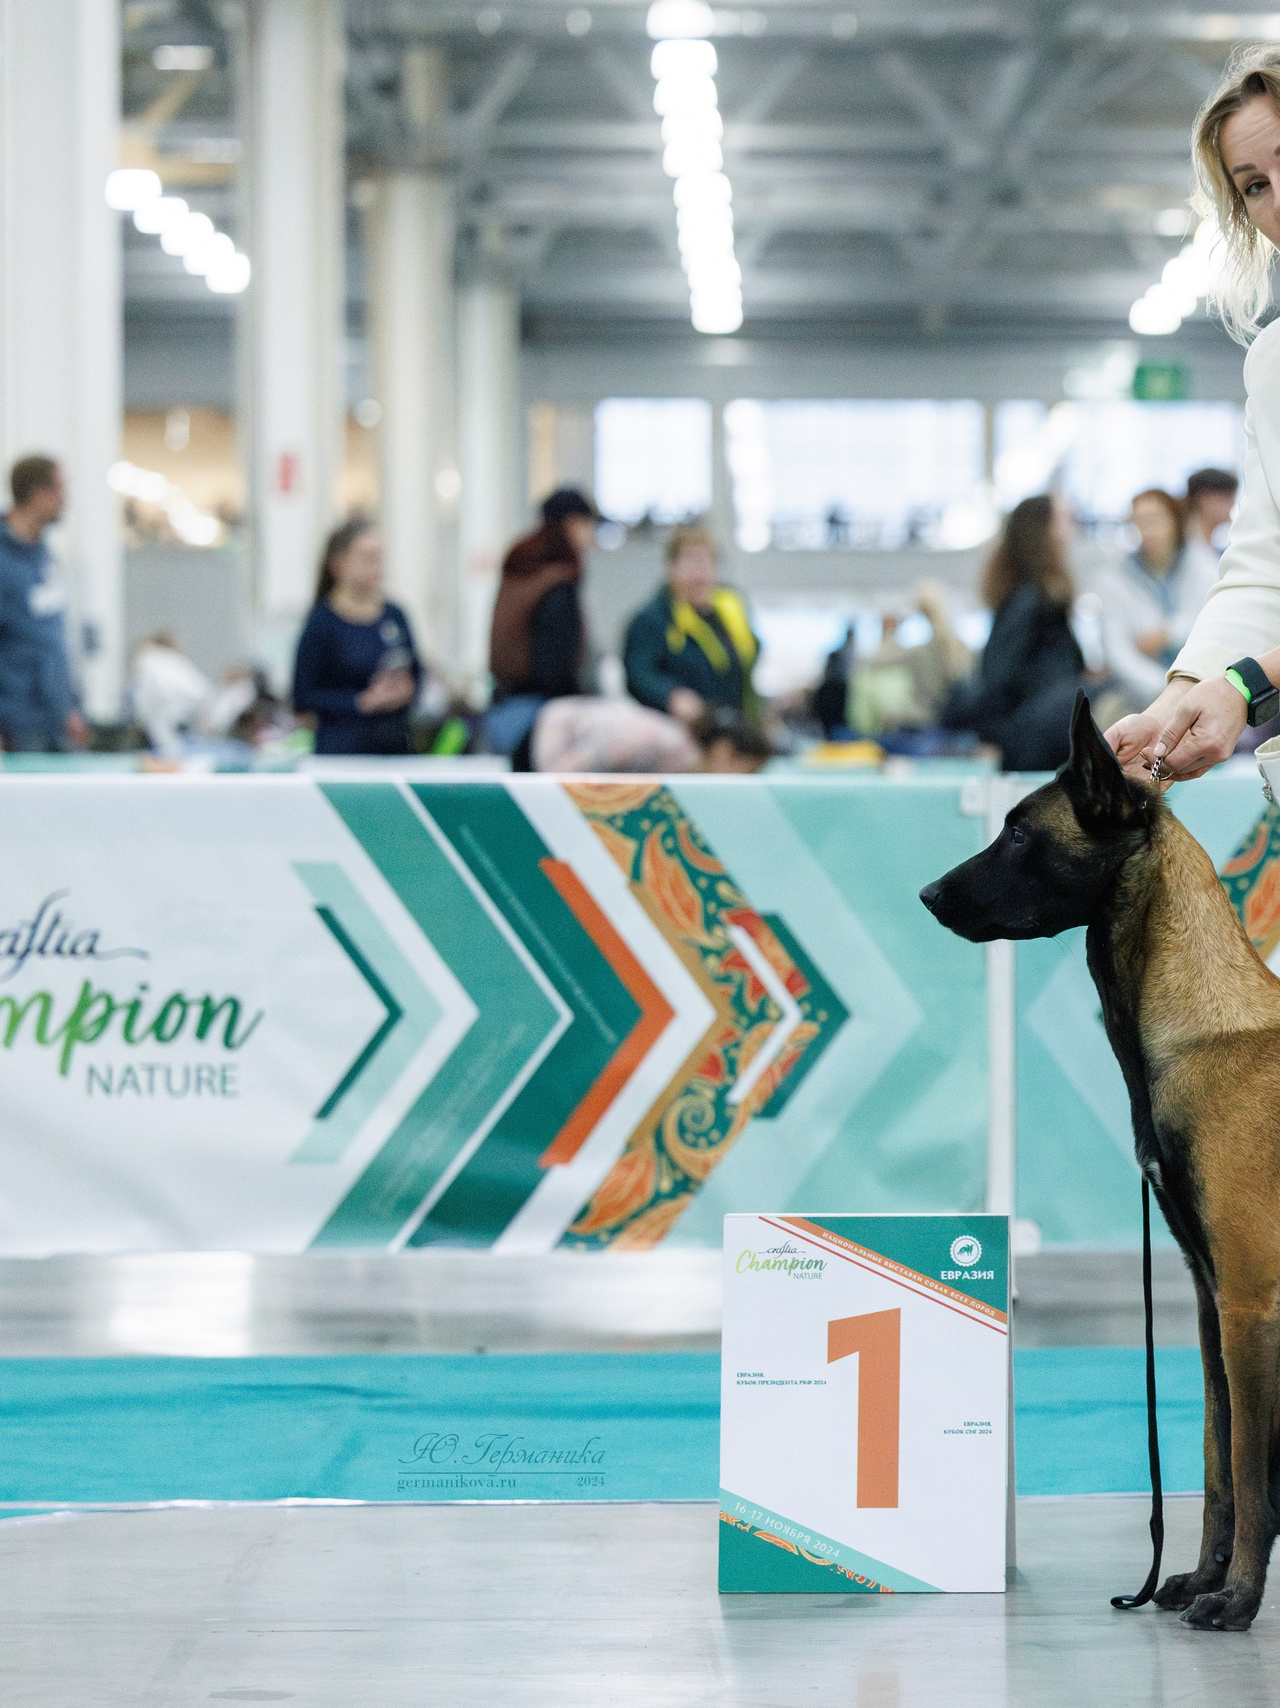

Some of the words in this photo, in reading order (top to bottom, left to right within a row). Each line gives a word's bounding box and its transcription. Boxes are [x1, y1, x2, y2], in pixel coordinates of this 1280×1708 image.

[87, 1063, 240, 1097] NATURE
[735, 1249, 828, 1276] Champion
[793, 1272, 822, 1280] NATURE
[822, 1231, 883, 1264] НАЦИОНАЛЬНЫЕ
[884, 1259, 923, 1282] ВЫСТАВКИ
[924, 1279, 949, 1295] СОБАК
[950, 1290, 969, 1304] ВСЕХ
[969, 1300, 996, 1317] ПОРОД
[940, 1270, 995, 1280] ЕВРАЗИЯ
[827, 1307, 901, 1508] 1
[734, 1502, 763, 1520] 16-17
[765, 1516, 812, 1545] НОЯБРЯ
[813, 1539, 841, 1558] 2024
